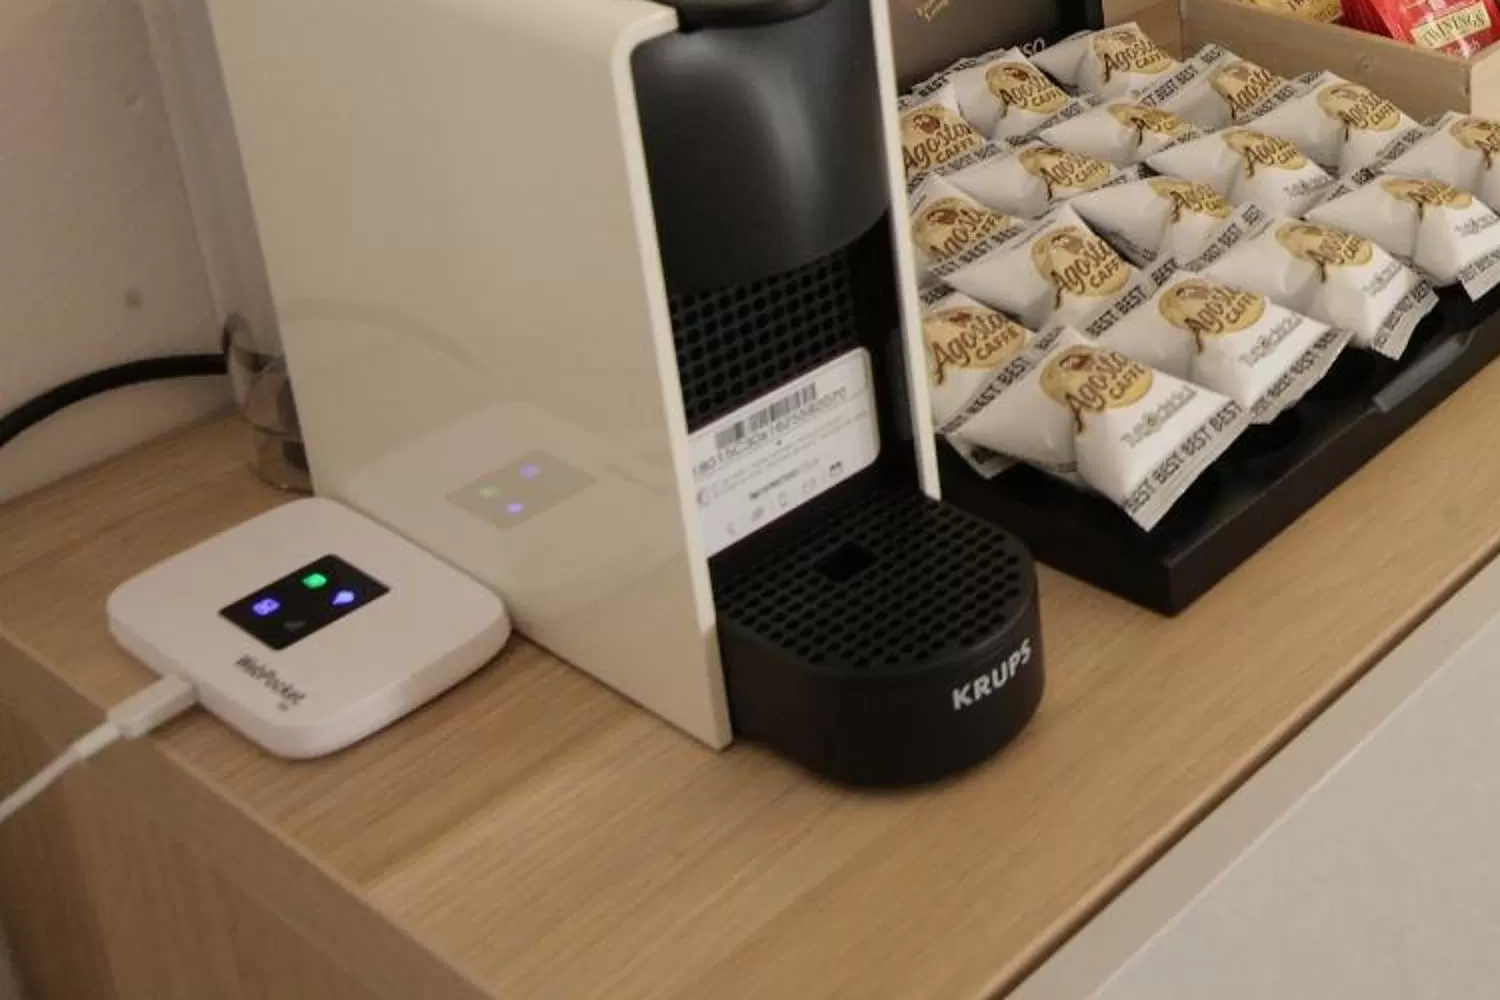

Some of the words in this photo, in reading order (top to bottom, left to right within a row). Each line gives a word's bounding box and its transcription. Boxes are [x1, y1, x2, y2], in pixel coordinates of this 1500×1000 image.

[932, 312, 1008, 385] Agosto
[1065, 351, 1129, 434] Agosto
[1152, 450, 1185, 485] BEST
[1182, 426, 1214, 457] BEST
[1209, 399, 1244, 433] BEST
[952, 637, 1032, 711] KRUPS
